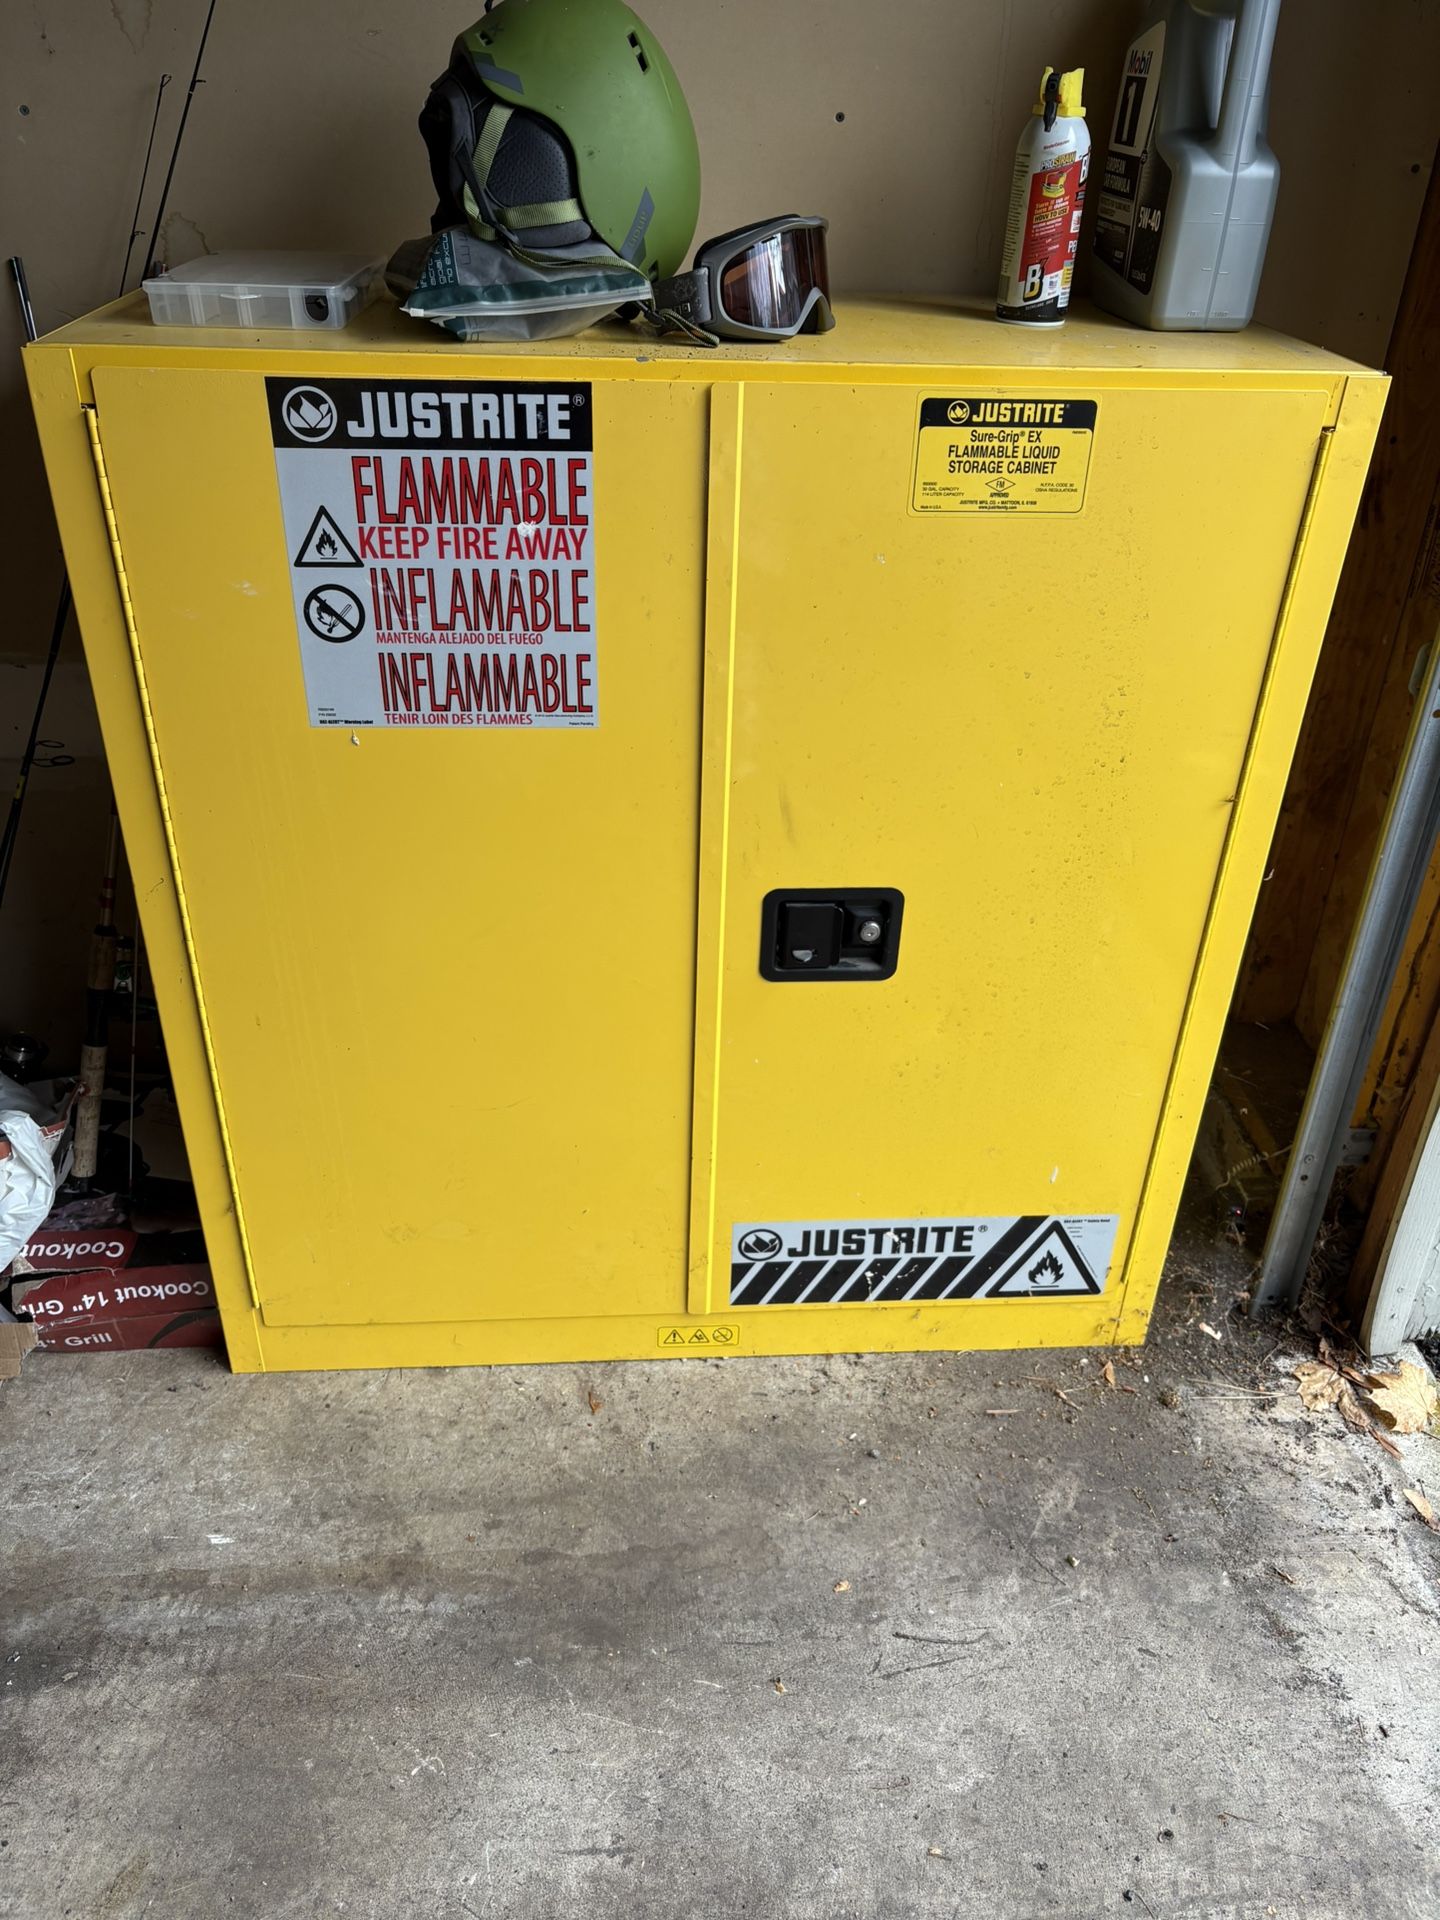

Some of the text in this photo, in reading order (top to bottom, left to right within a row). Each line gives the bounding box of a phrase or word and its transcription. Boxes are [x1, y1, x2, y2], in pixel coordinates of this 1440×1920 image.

[1128, 50, 1153, 75] Mobil
[1138, 206, 1162, 233] 5W-40
[1027, 430, 1042, 443] EX
[948, 445, 1060, 460] FLAMMABLE LIQUID
[948, 460, 1057, 474] STORAGE CABINET
[351, 456, 589, 526] FLAMMABLE
[358, 527, 588, 560] KEEP FIRE AWAY
[369, 568, 591, 632] INFLAMABLE
[376, 632, 544, 645] MANTENGA ALEJADO DEL FUEGO
[378, 653, 593, 713] INFLAMMABLE
[384, 713, 533, 725] TENIR LOIN DES FLAMMES
[19, 1242, 125, 1259] Cookout
[73, 1291, 109, 1312] 14"
[114, 1281, 209, 1304] Cookout
[65, 1332, 113, 1346] Grill
